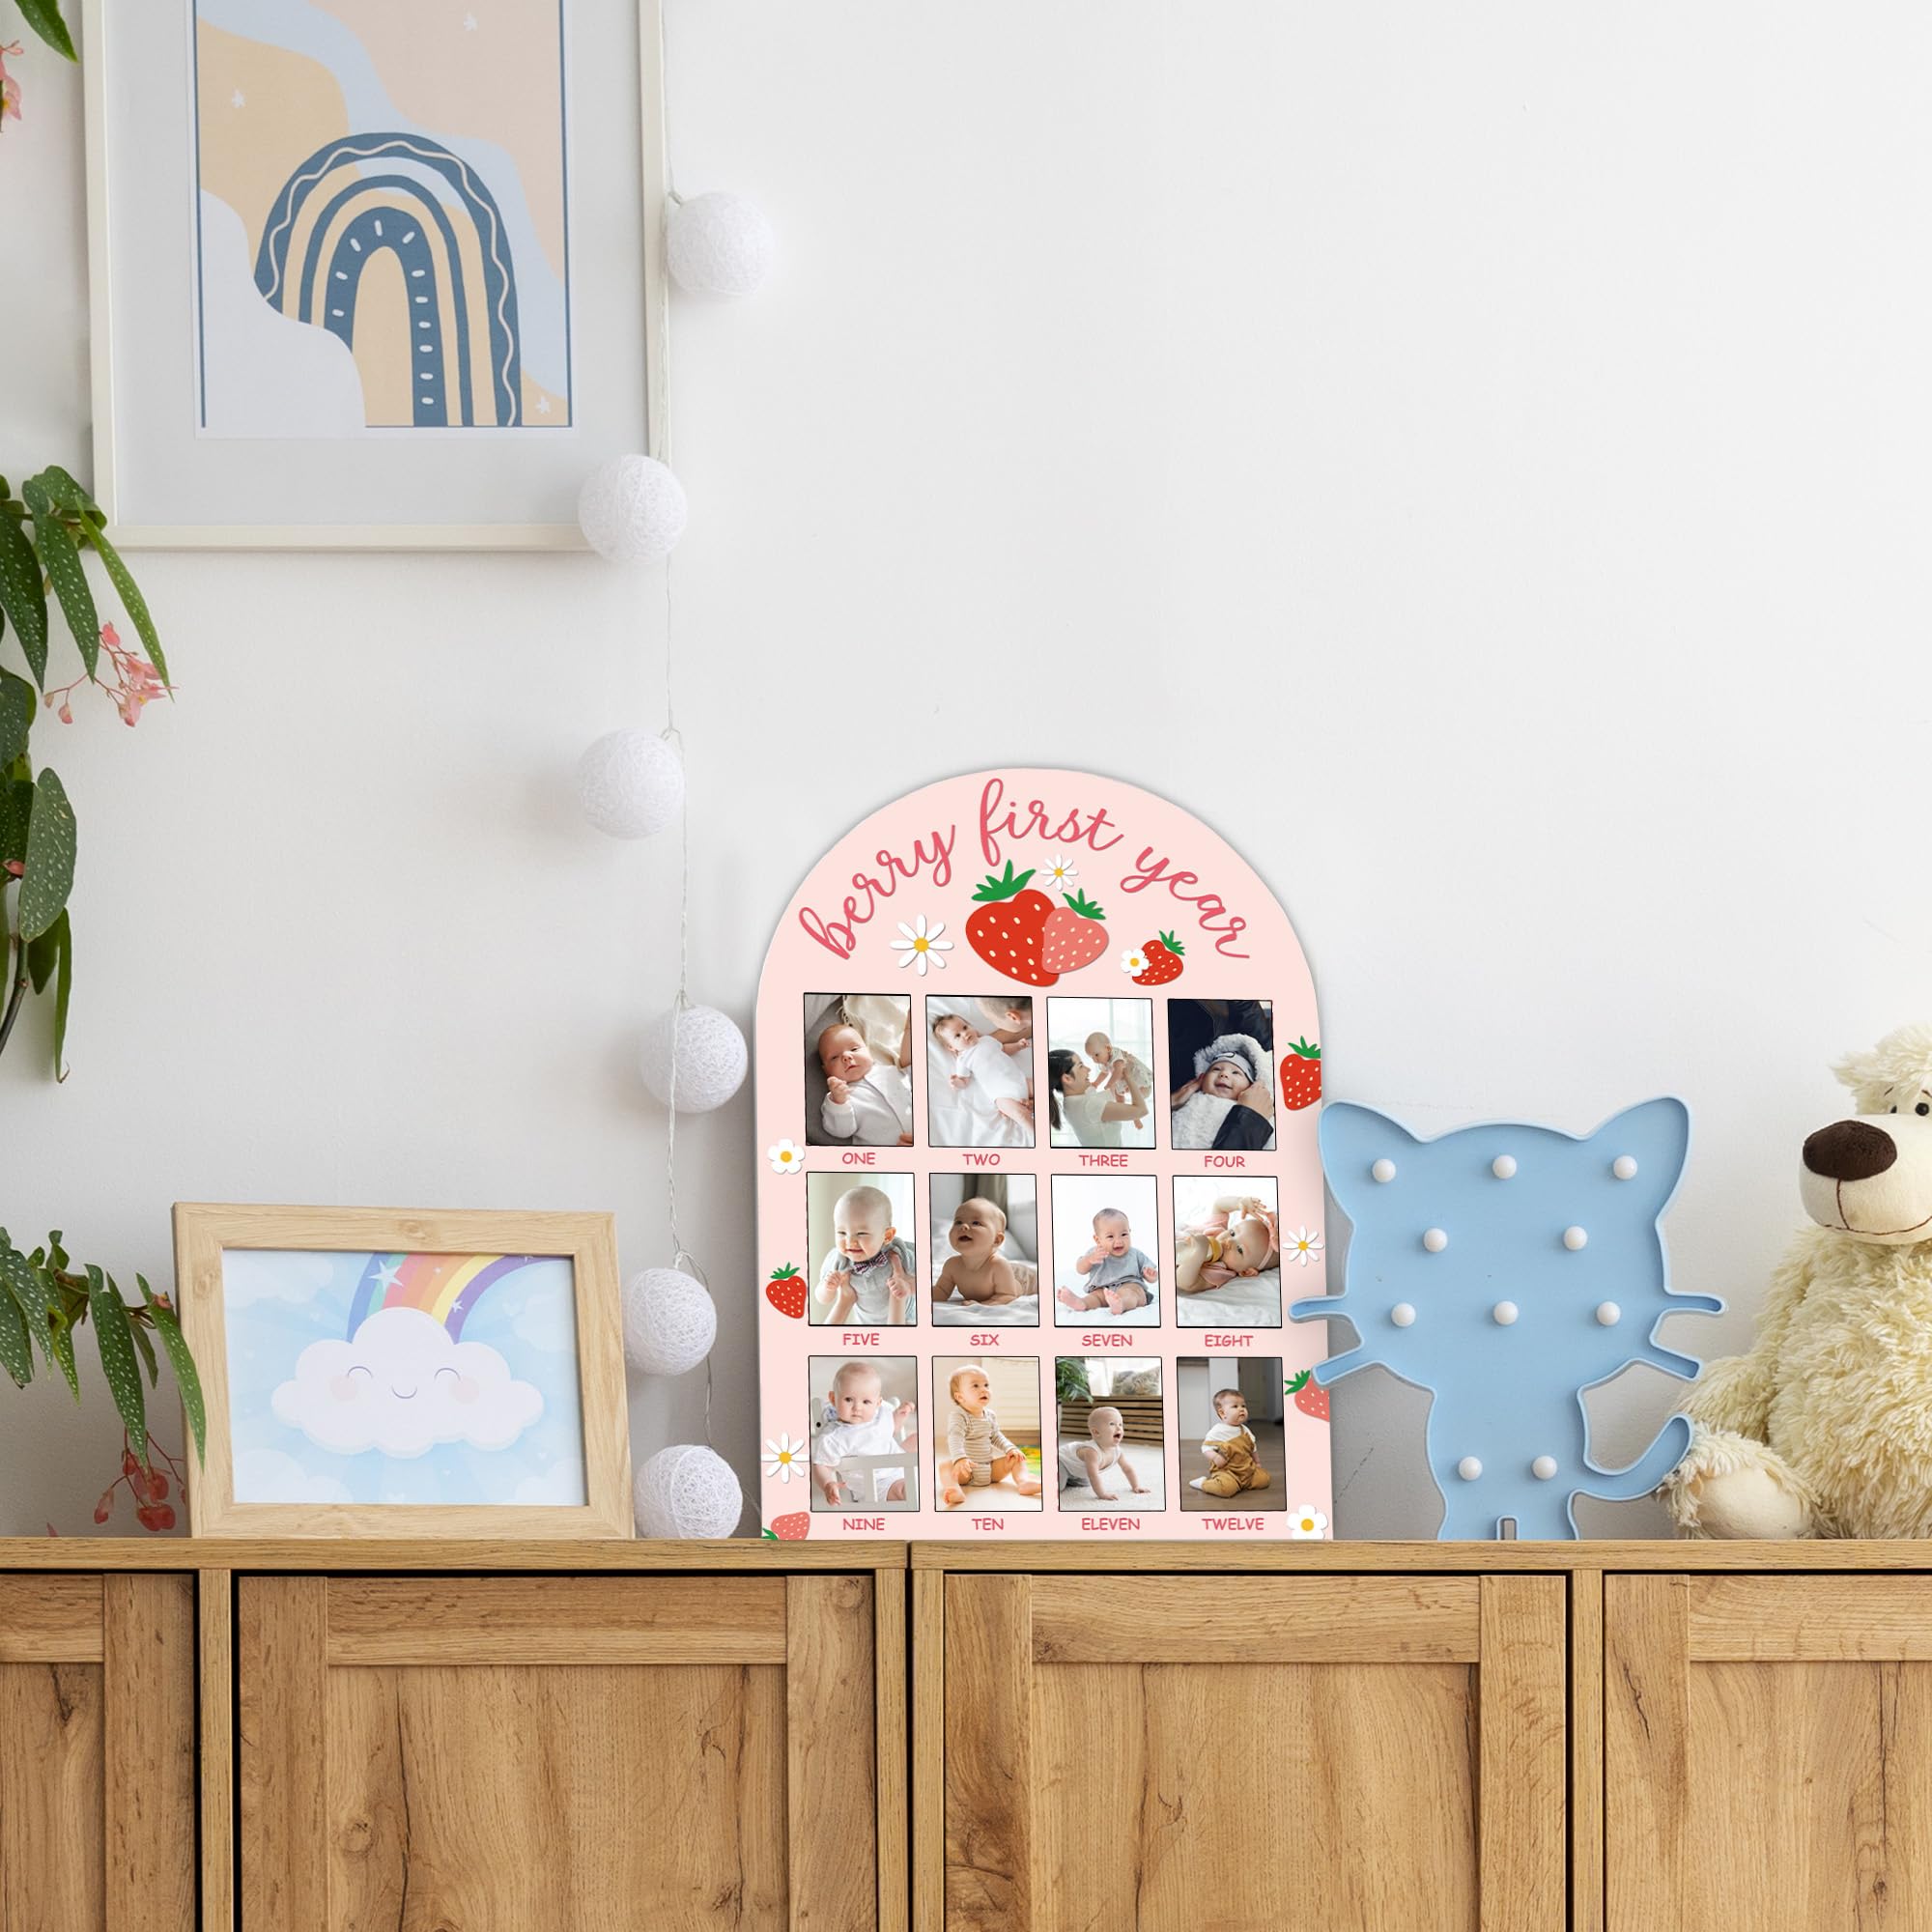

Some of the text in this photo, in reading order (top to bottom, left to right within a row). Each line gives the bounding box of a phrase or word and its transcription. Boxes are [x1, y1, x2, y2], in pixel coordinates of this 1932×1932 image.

[799, 778, 1250, 959] berry first year
[841, 1151, 876, 1166] ONE
[962, 1152, 1001, 1167] TWO
[1078, 1152, 1128, 1168] THREE
[1204, 1154, 1246, 1169] FOUR
[842, 1332, 880, 1347] FIVE
[969, 1333, 999, 1347] SIX
[1081, 1333, 1133, 1348] SEVEN
[1205, 1333, 1254, 1348] EIGHT
[842, 1517, 886, 1531] NINE
[971, 1517, 1005, 1531] TEN
[1081, 1517, 1141, 1531] ELEVEN
[1203, 1517, 1264, 1531] TWELVE
